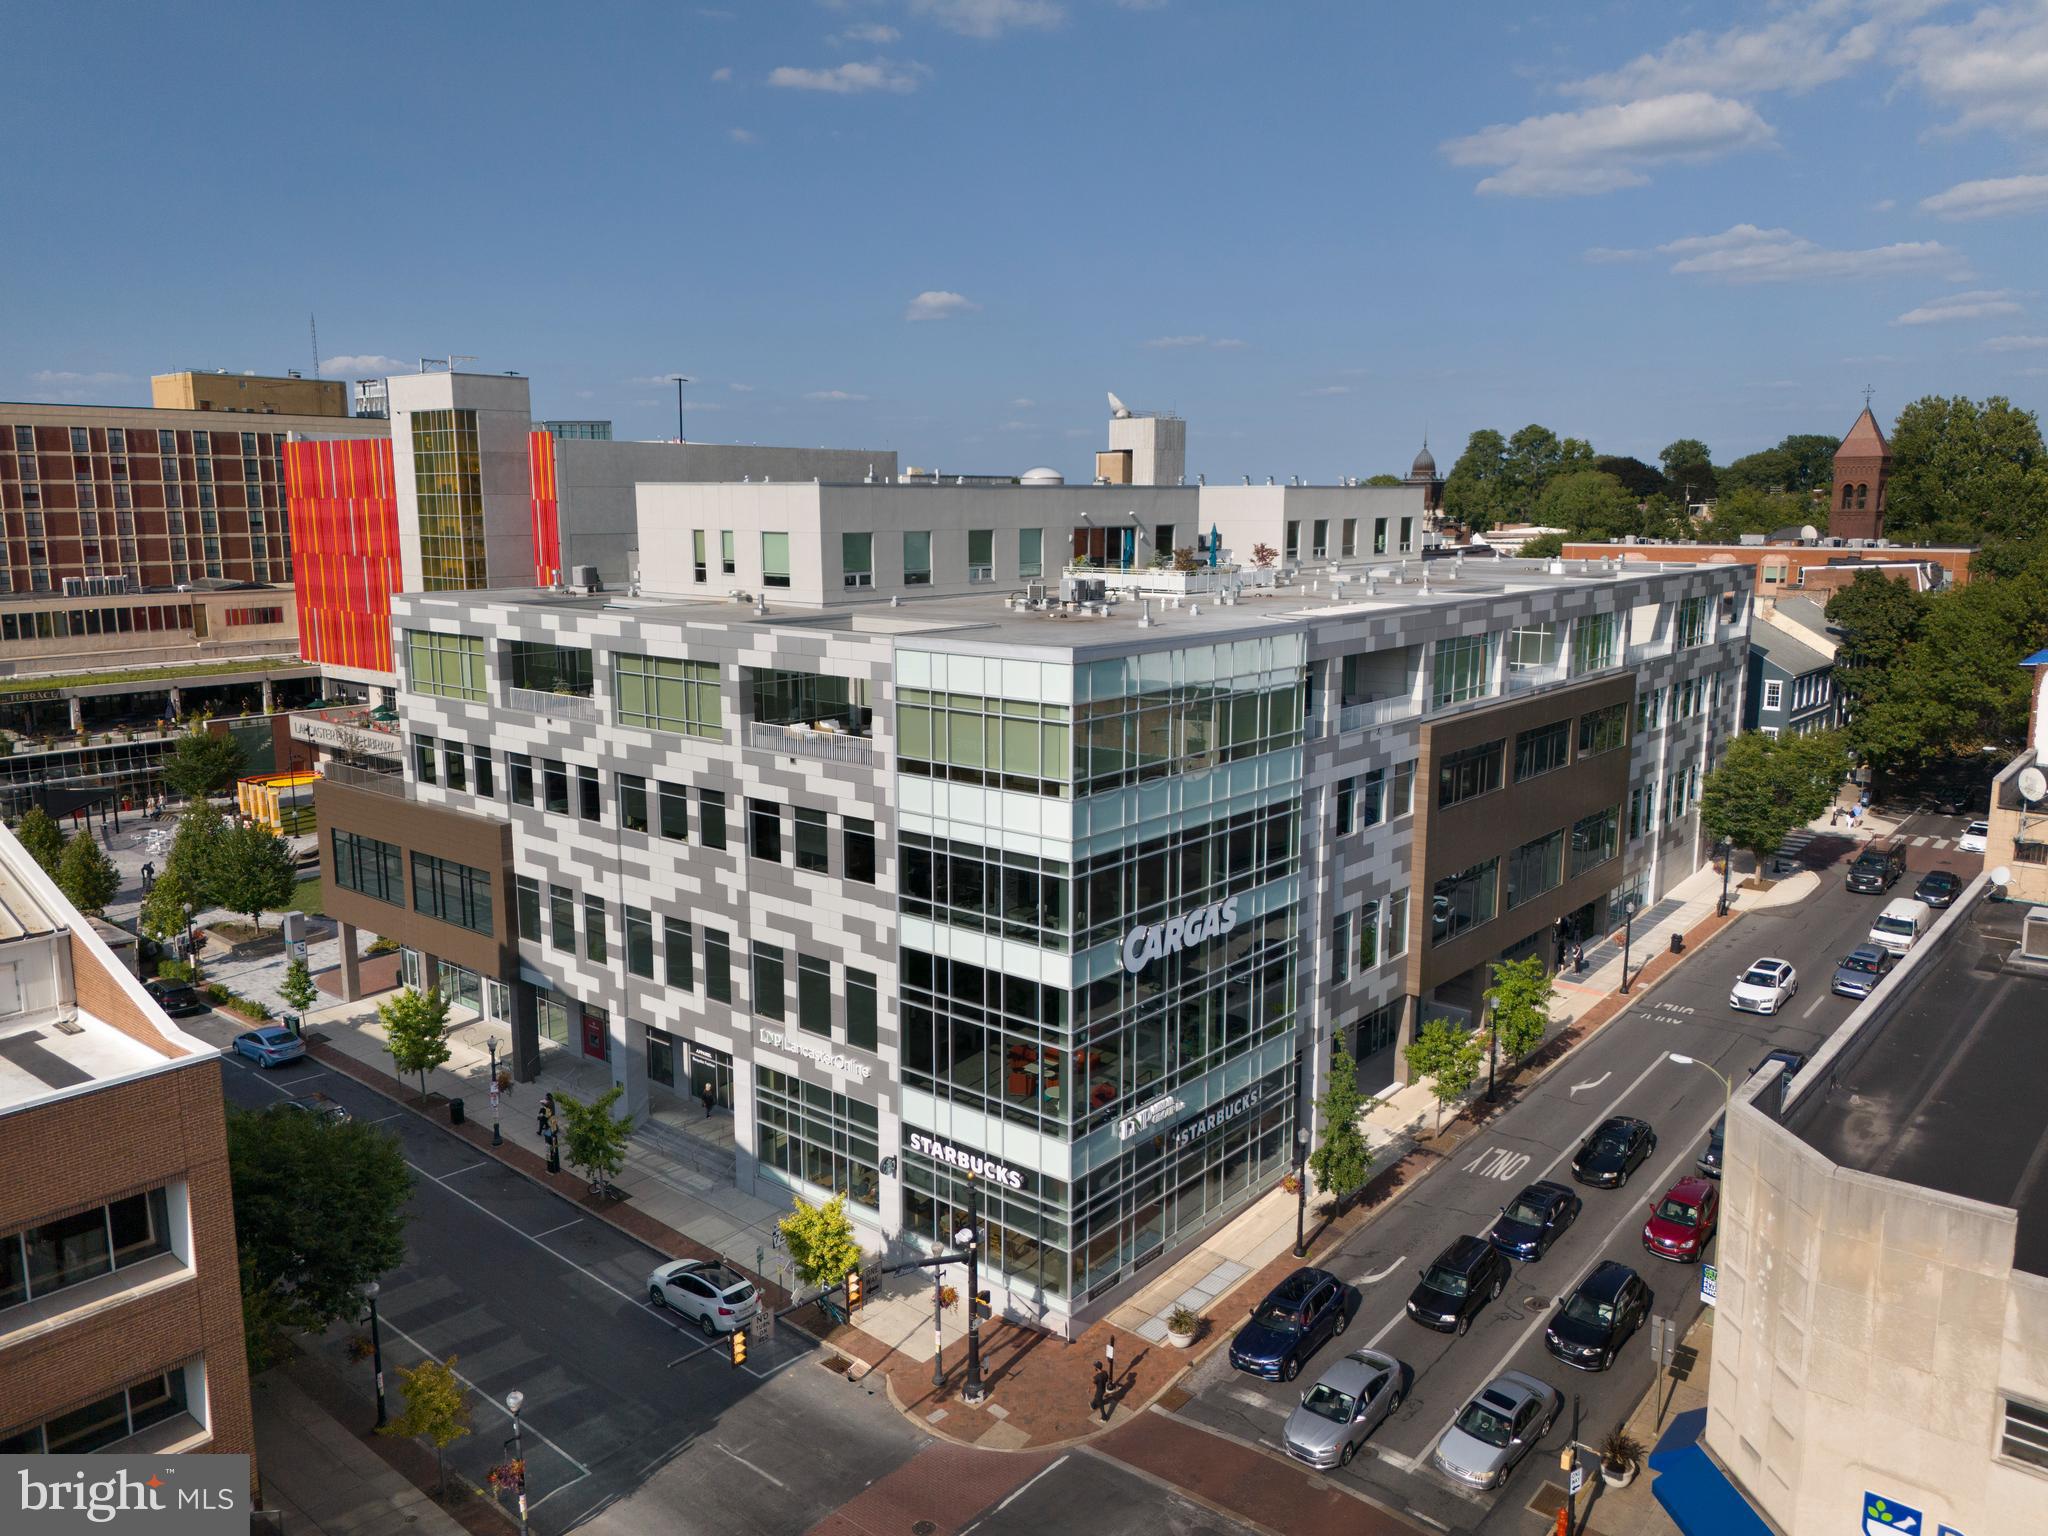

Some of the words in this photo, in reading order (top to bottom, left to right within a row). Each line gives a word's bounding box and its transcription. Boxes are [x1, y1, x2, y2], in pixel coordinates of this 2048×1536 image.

[1123, 896, 1239, 973] CARGAS
[1181, 1090, 1258, 1147] STARBUCKS
[910, 1133, 1021, 1189] STARBUCKS
[1461, 1146, 1531, 1181] ONLY
[866, 1265, 881, 1277] ONE
[756, 1312, 769, 1323] NO
[759, 1328, 768, 1336] ON
[1572, 1471, 1581, 1479] ONE
